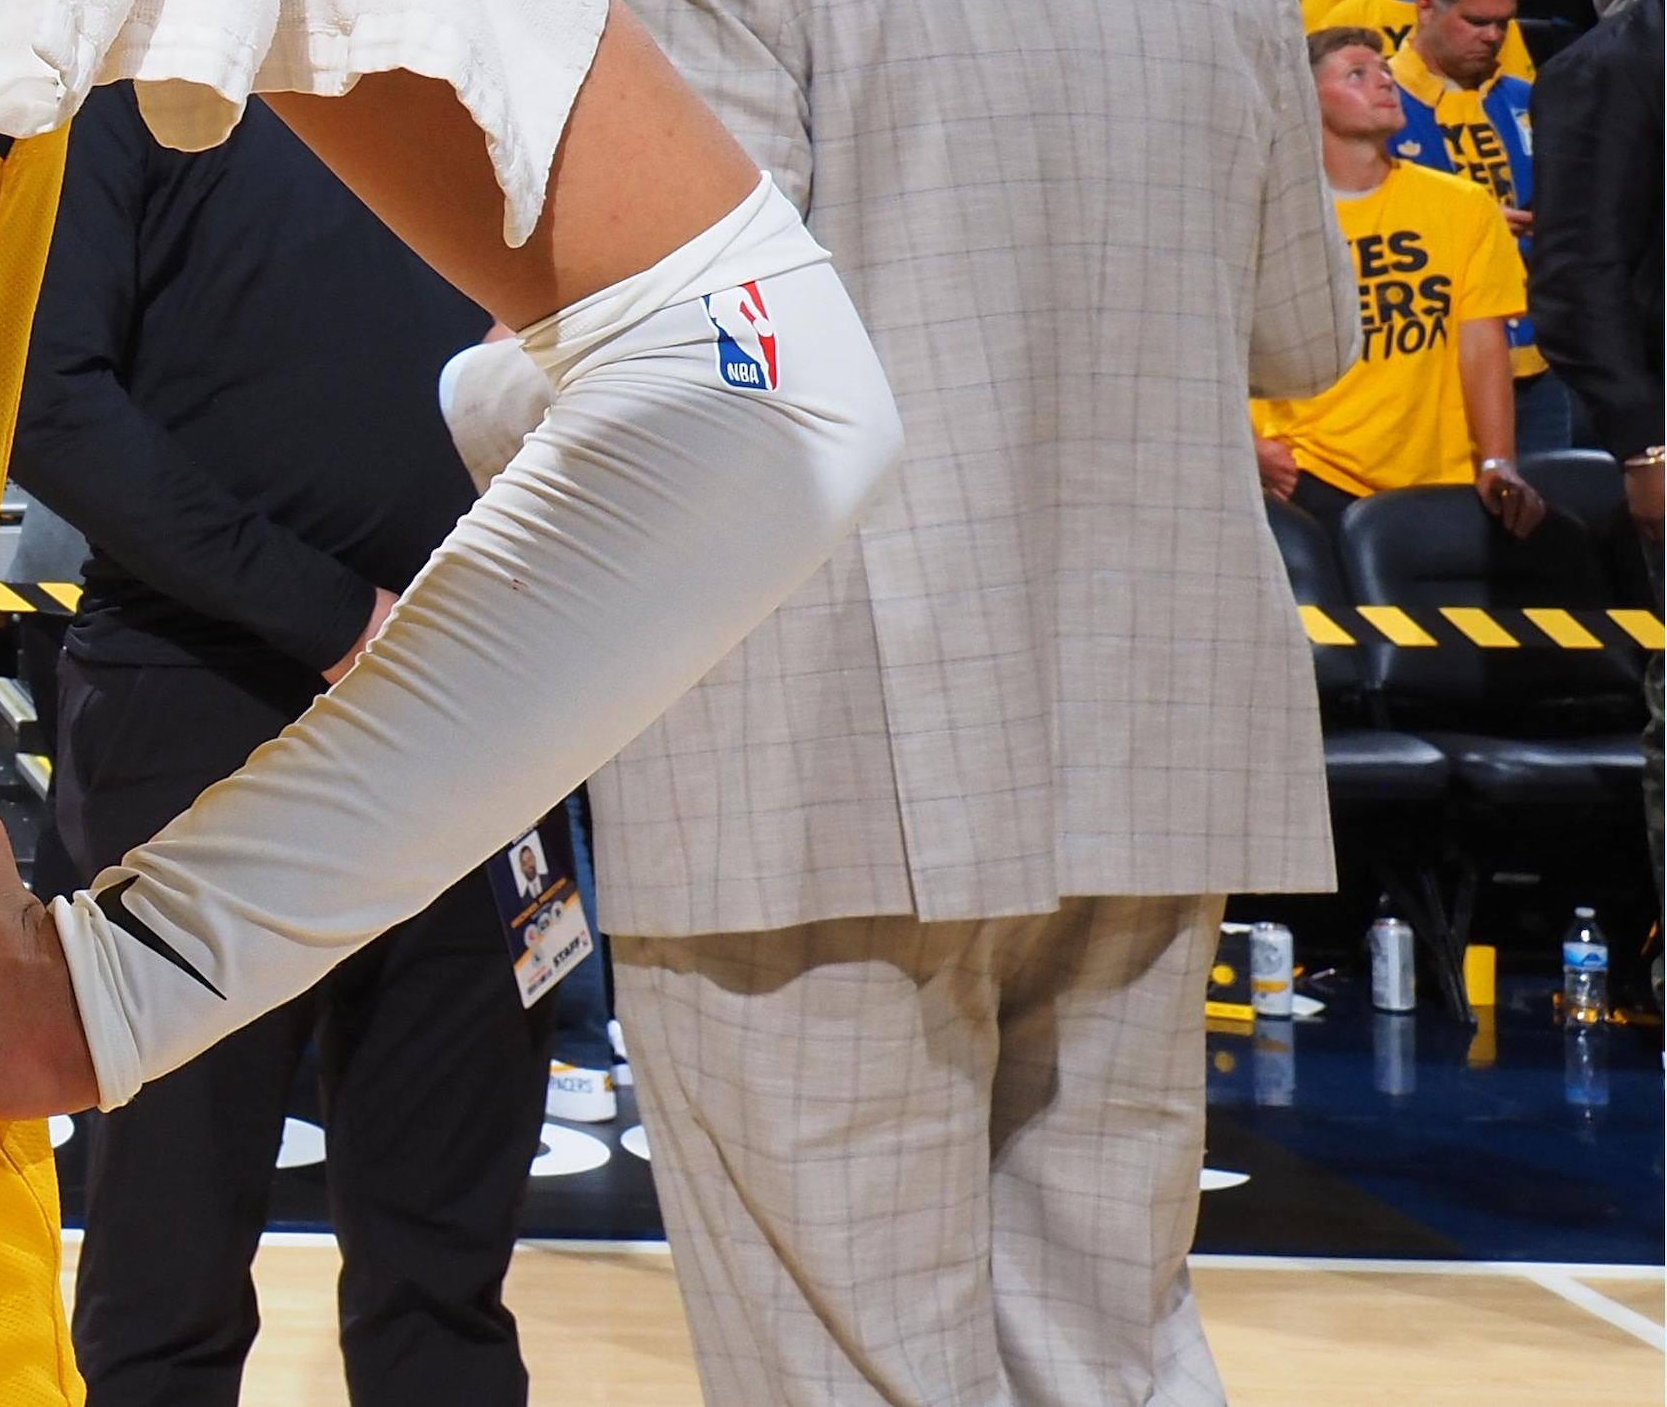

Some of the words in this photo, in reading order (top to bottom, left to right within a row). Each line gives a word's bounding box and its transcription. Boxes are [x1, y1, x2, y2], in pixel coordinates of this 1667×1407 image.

[1440, 122, 1501, 158] YE
[1348, 230, 1429, 278] ES
[1357, 275, 1452, 327] RS
[1362, 312, 1448, 363] TION
[726, 361, 760, 385] NBA
